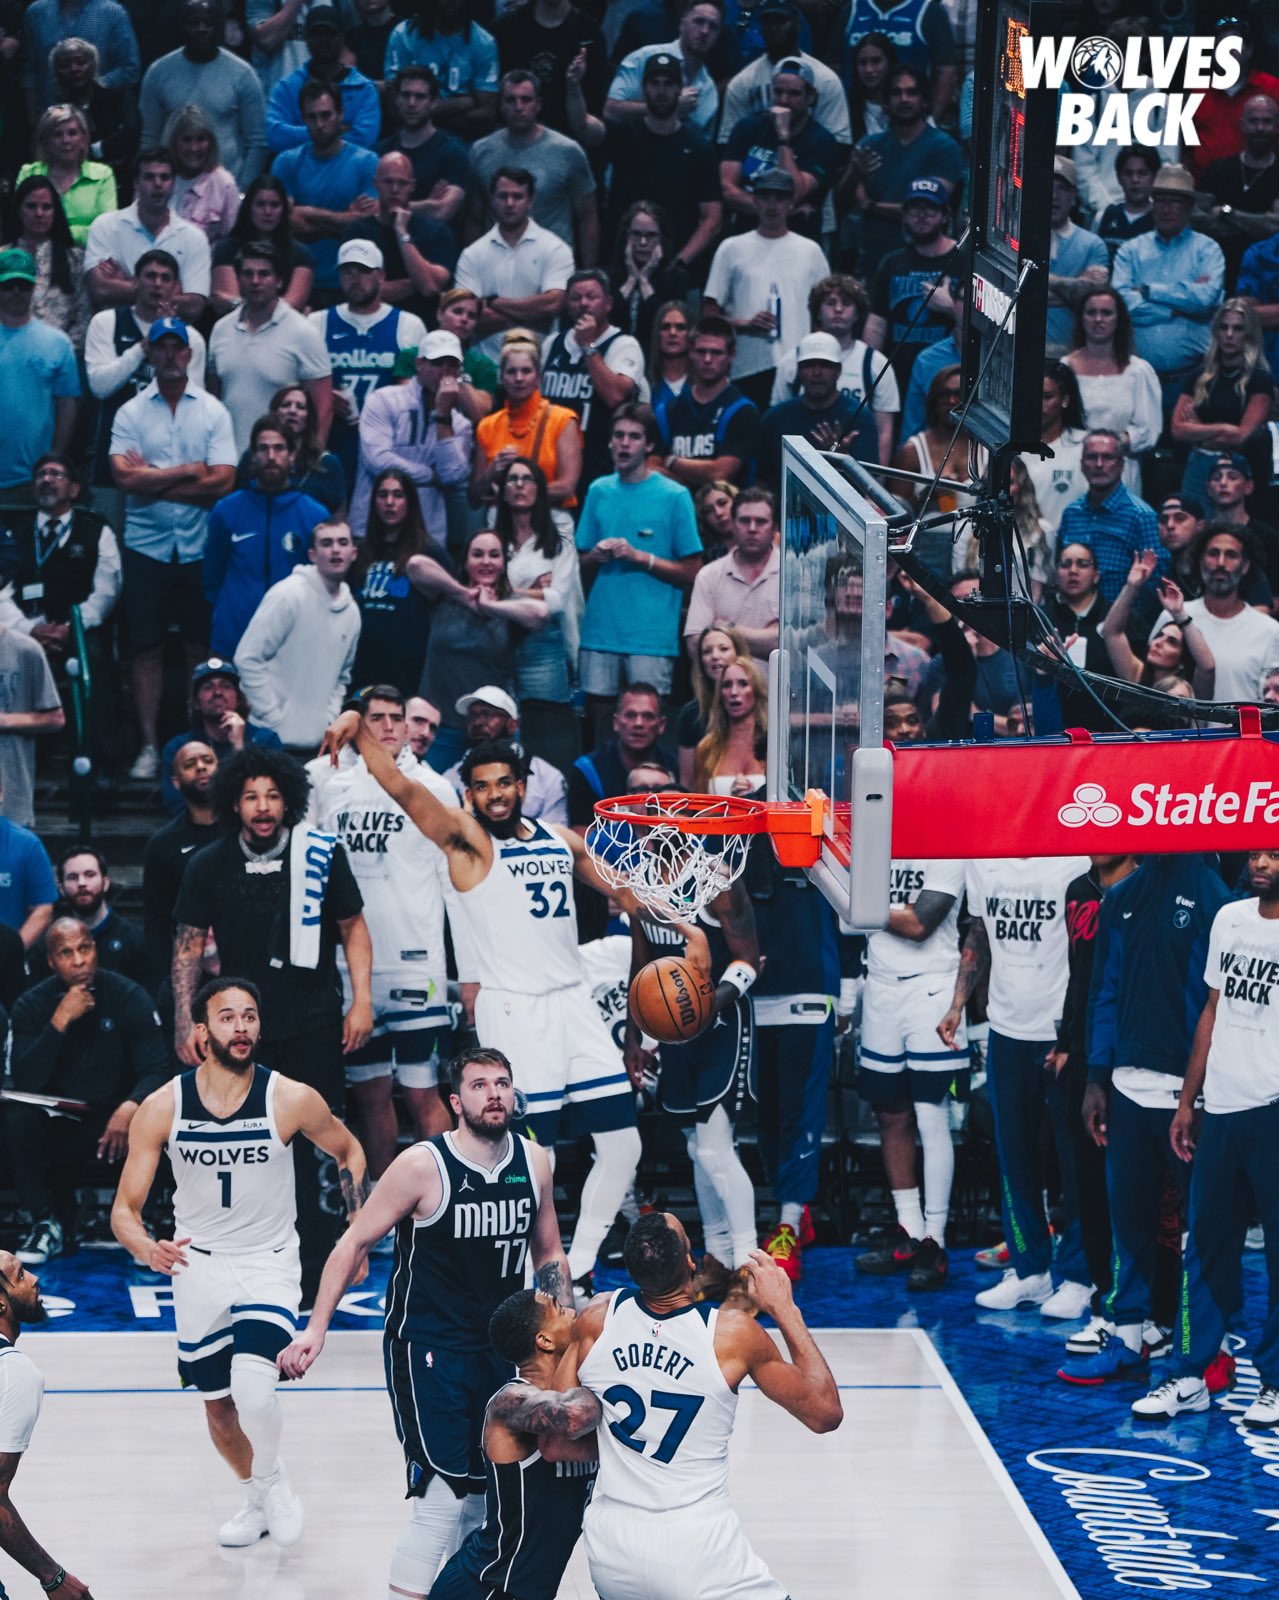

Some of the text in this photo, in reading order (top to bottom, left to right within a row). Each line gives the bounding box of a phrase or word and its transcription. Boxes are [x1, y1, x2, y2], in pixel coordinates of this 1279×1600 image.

[542, 371, 593, 399] MAVS
[1127, 782, 1240, 826] State
[507, 860, 573, 878] WOLVES
[525, 881, 570, 918] 32
[995, 920, 1043, 942] BACK
[1219, 951, 1279, 985] WOLVE
[669, 968, 697, 1027] Wilson
[1224, 976, 1272, 1006] BACK
[179, 1145, 269, 1166] WOLVES
[217, 1171, 231, 1208] 1
[505, 1174, 527, 1184] chime
[454, 1198, 531, 1239] MAVS
[494, 1238, 527, 1278] 77
[612, 1343, 694, 1380] GOBERT
[603, 1384, 705, 1464] 27
